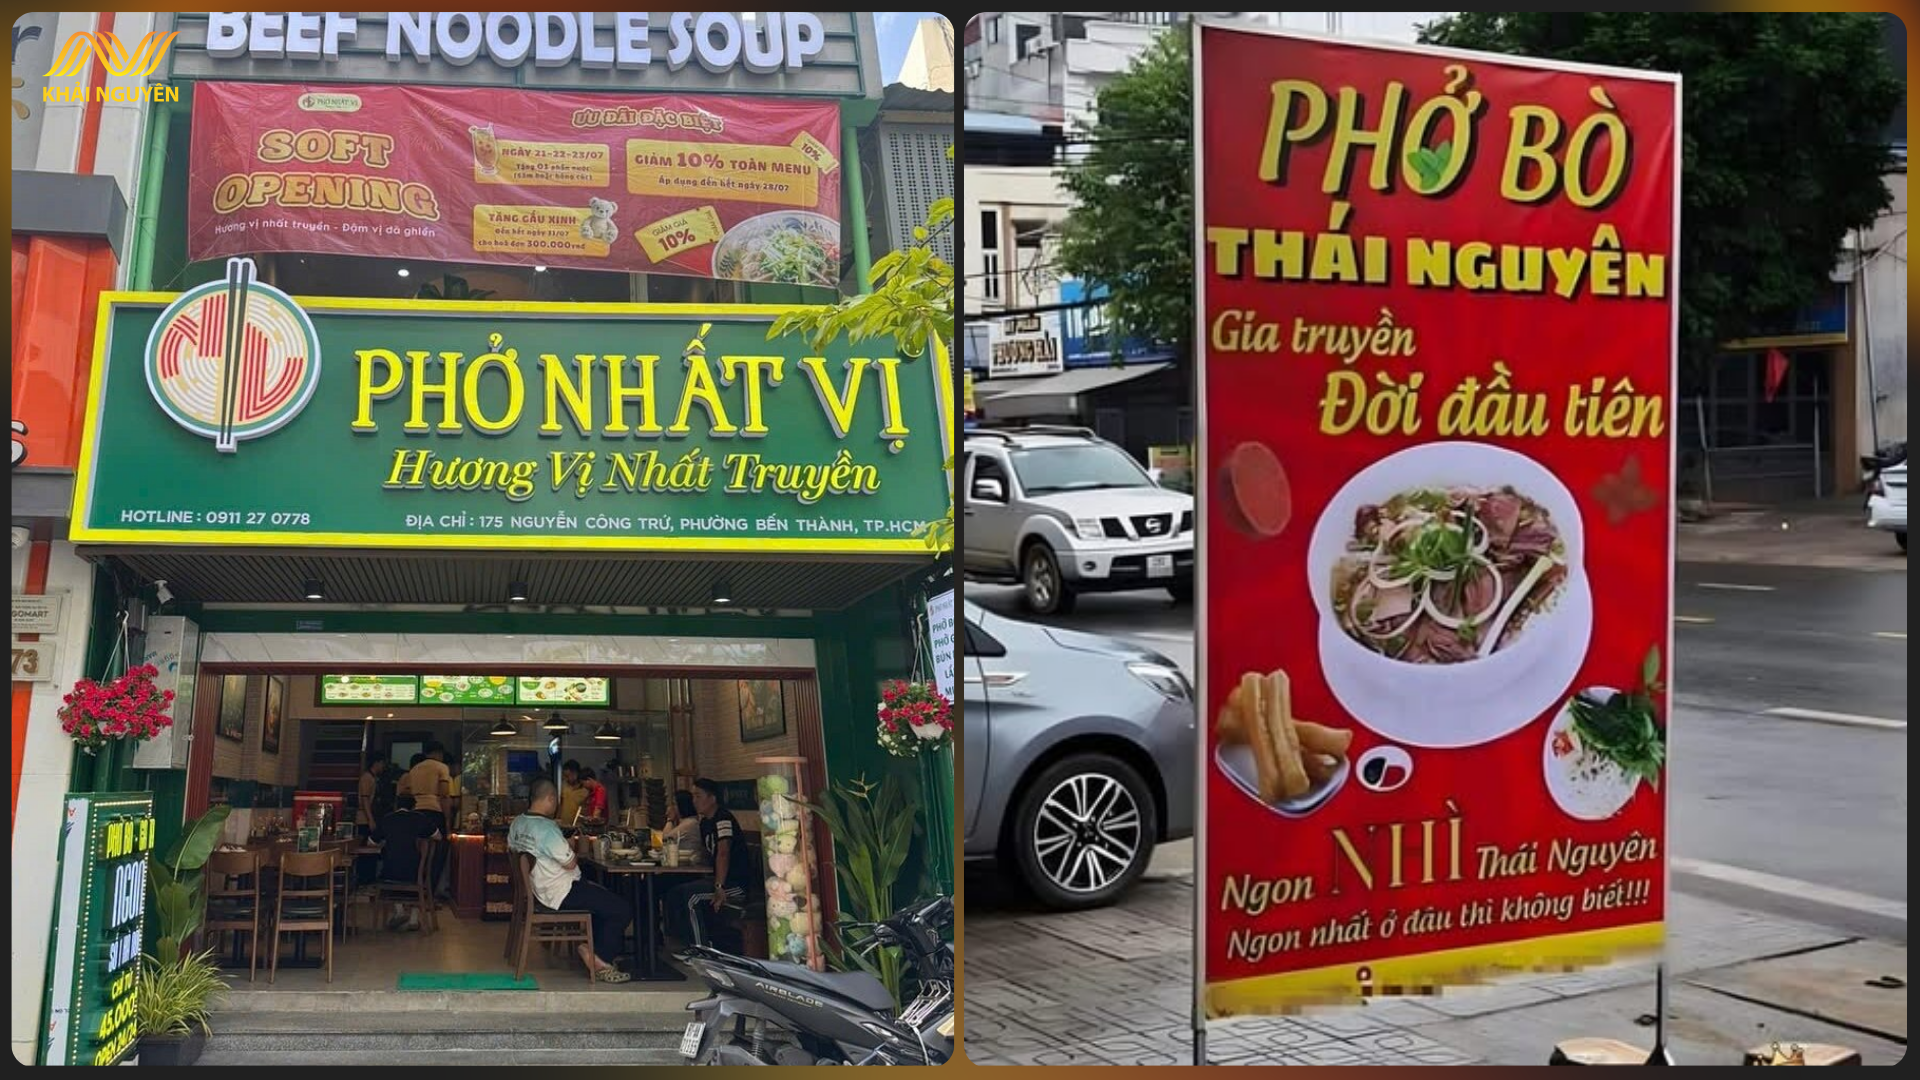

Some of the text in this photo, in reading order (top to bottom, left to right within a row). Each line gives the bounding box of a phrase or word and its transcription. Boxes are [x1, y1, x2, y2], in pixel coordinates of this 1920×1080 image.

[206, 12, 825, 74] BEEF NOODLE SOUP
[572, 107, 600, 127] ƯU
[638, 107, 679, 129] ĐẶC
[1258, 64, 1633, 210] PHỞ BÒ
[258, 129, 393, 168] SOFT
[677, 152, 724, 169] 10%
[730, 157, 767, 171] TOÀN
[772, 162, 811, 175] MENU
[801, 142, 821, 161] 10%
[214, 172, 440, 221] OPENING
[249, 220, 259, 230] vị
[372, 225, 383, 236] vị
[548, 215, 576, 225] XINH
[658, 228, 696, 251] 10%
[1207, 201, 1666, 299] THÁI NGUYÊN
[1212, 306, 1417, 364] Gia truyền
[351, 323, 910, 454] PHỞ NHẤT VỊ
[1318, 361, 1665, 439] Đời đầu tiên
[383, 447, 882, 504] Hương Vị Nhất Truyền
[121, 510, 193, 524] HOTLINE
[206, 511, 241, 525] 0911
[246, 512, 266, 525] 27
[271, 513, 311, 526] 0778
[405, 514, 435, 531] ĐỊA
[439, 511, 466, 527] CHỈ
[479, 515, 503, 528] 175
[511, 510, 578, 529] NGUYỄN
[585, 513, 632, 530] CÔNG
[638, 514, 674, 533] TRỨ,
[680, 514, 748, 532] PHƯỜNG
[756, 513, 789, 532] BẾN
[796, 515, 858, 534] THÀNH,
[863, 519, 927, 534] TP.HCM
[1221, 800, 1658, 915] Ngon NHÌ Thái Nguyên
[1227, 879, 1650, 962] Ngon nhất ở đâu thì không biết!!!
[755, 982, 824, 1008] AIRBLADE
